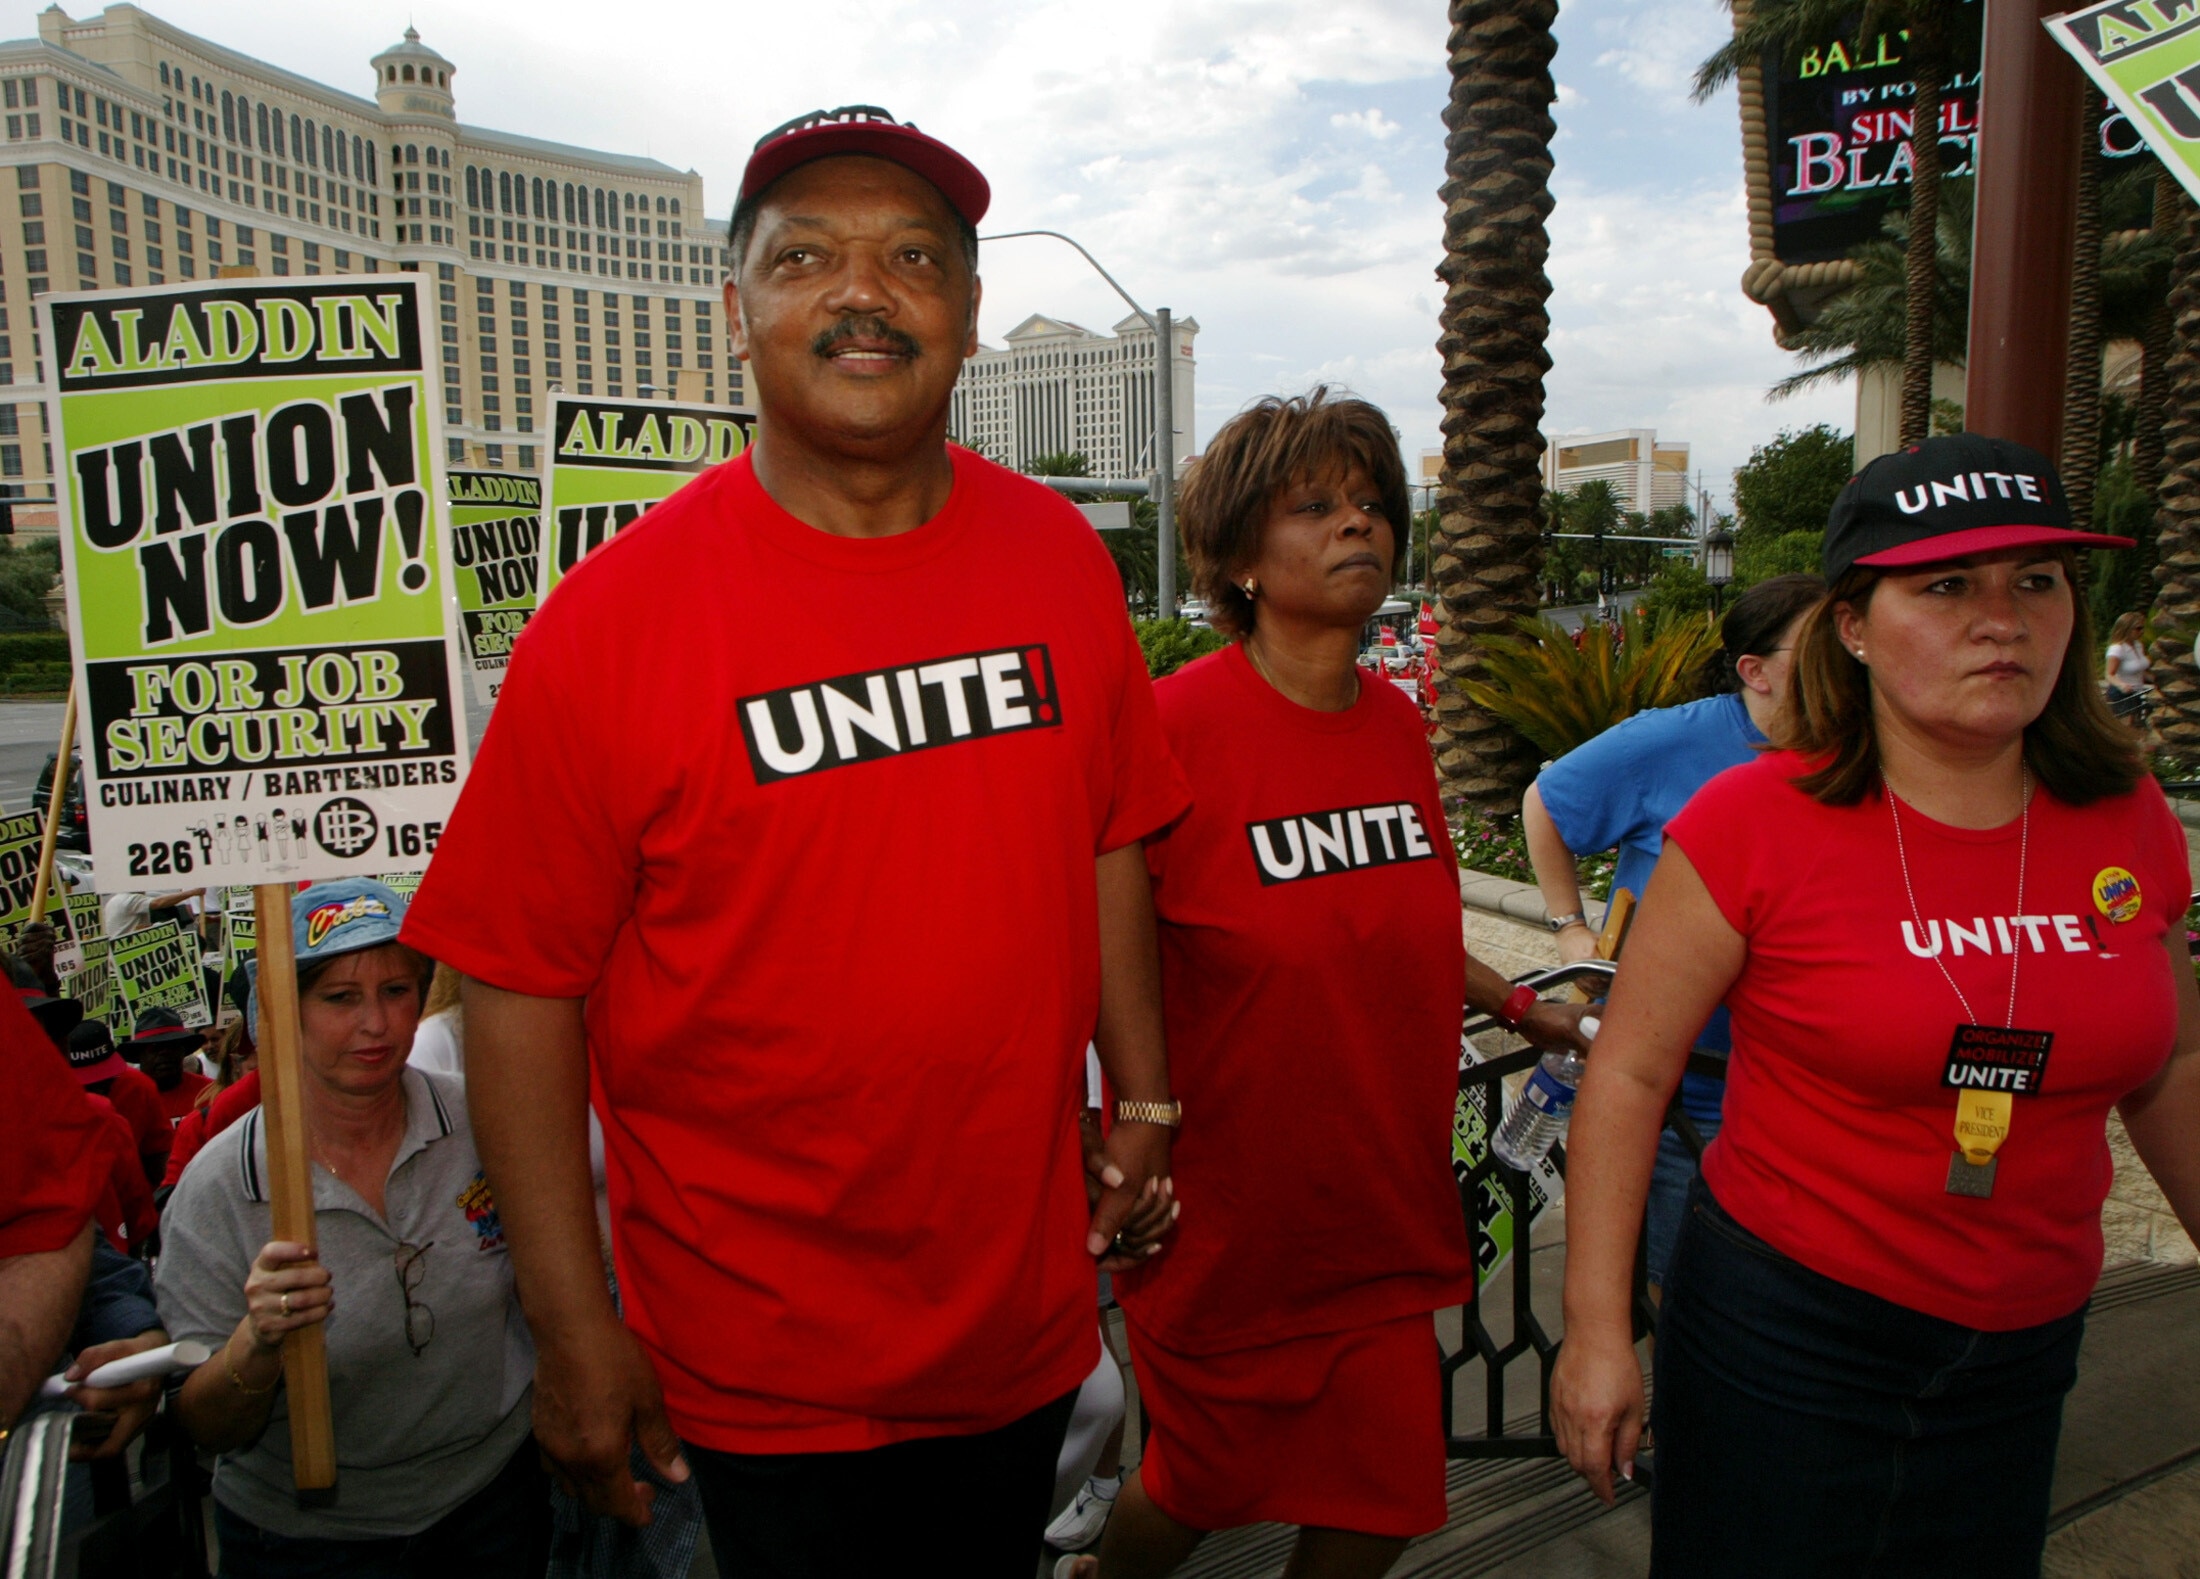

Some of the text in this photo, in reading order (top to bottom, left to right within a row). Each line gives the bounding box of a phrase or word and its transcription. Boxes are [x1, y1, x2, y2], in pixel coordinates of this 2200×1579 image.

[2098, 0, 2200, 57] AL
[1842, 87, 1875, 107] BY
[1851, 100, 1980, 145] SINL
[65, 294, 402, 378] ALADDIN
[75, 385, 416, 549] UNION
[447, 475, 540, 505] LADDIN
[140, 489, 427, 647] NOW!
[128, 651, 404, 717] FOR JOB
[746, 648, 1054, 774] UNITE!
[107, 699, 437, 772] SECURITY
[100, 776, 231, 808] CULINARY
[264, 760, 457, 797] BARTENDERS
[128, 840, 194, 876] 226
[386, 822, 442, 858] 165
[114, 923, 177, 952] ALADDIN
[1900, 914, 2108, 958] UNITE!
[120, 939, 183, 981] UNION
[136, 956, 190, 995] NOW!
[70, 1044, 109, 1061] UNITE
[1957, 1047, 2043, 1067] MOBILIZE!
[1962, 1030, 2048, 1049] ORGANIZE!
[1949, 1063, 2038, 1091] UNITE!
[1959, 1120, 2006, 1140] PRESIDENT
[1974, 1104, 1995, 1121] VICE
